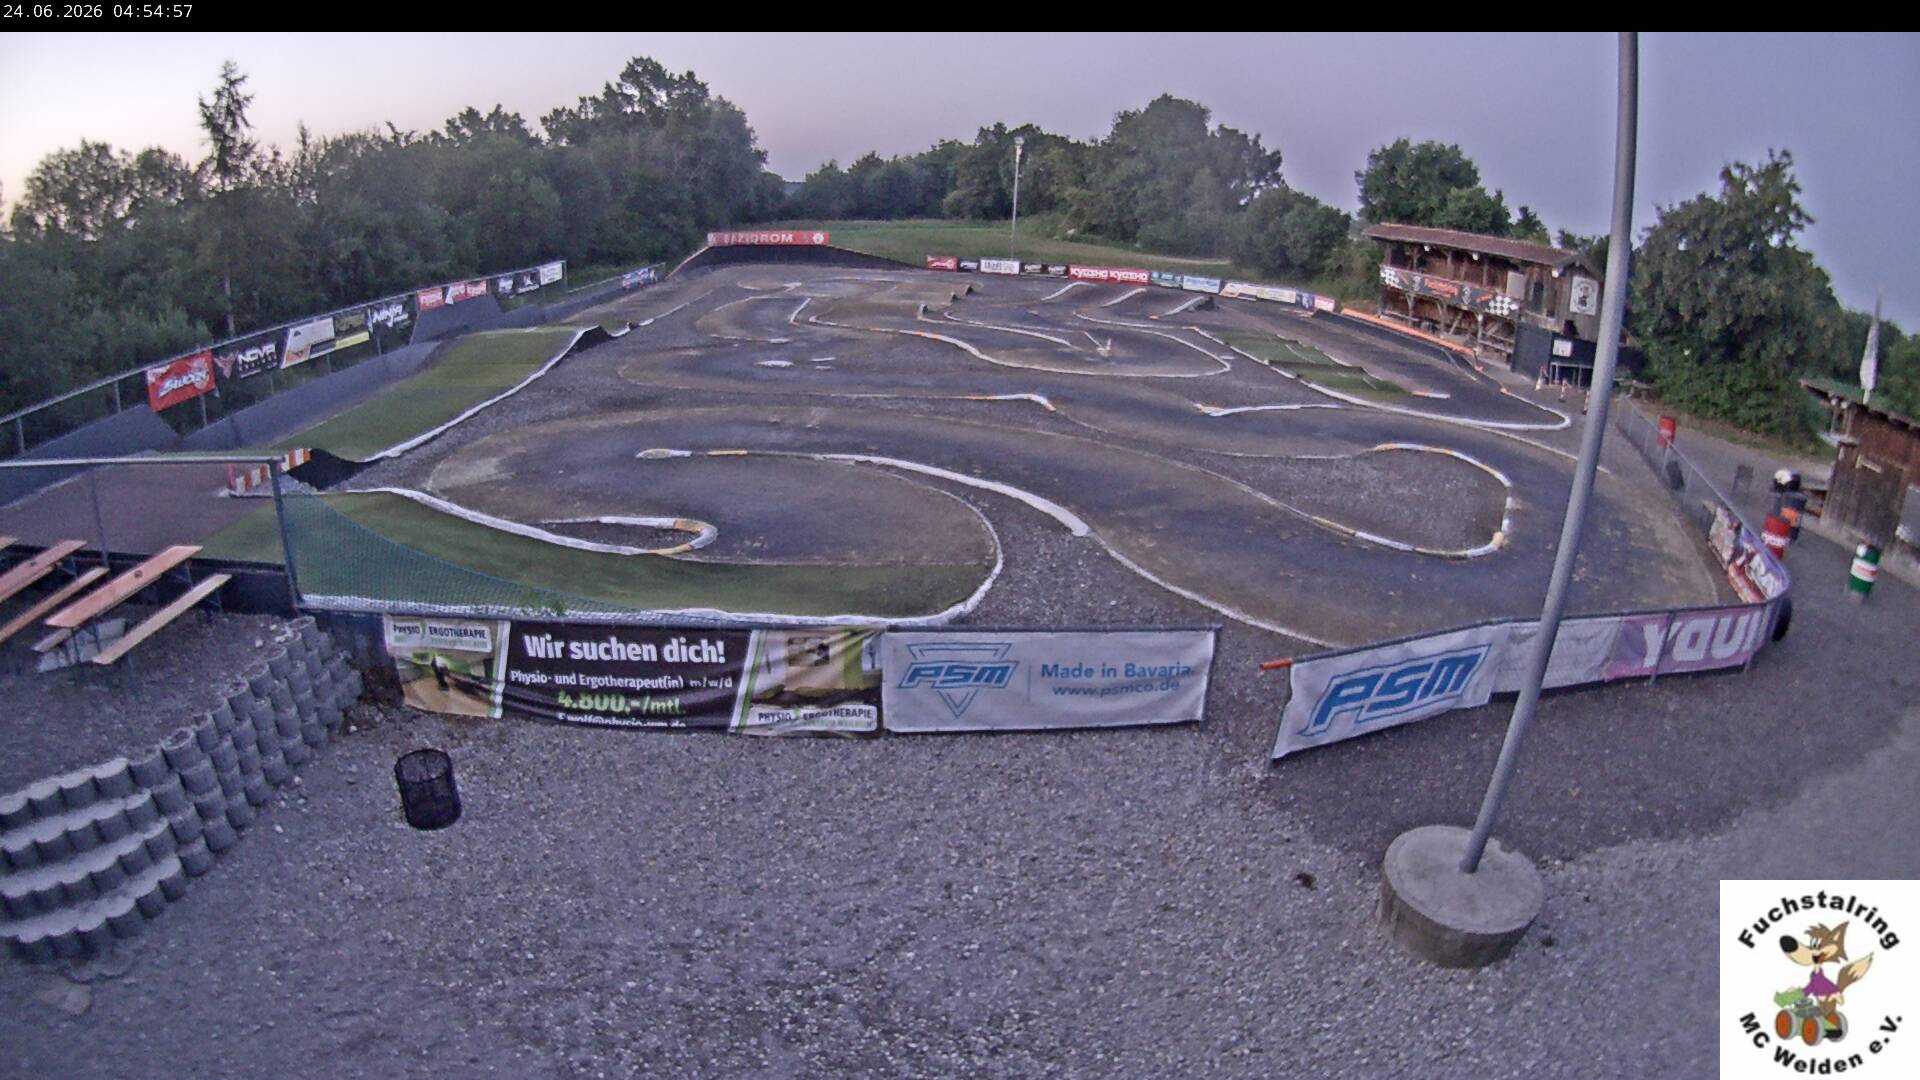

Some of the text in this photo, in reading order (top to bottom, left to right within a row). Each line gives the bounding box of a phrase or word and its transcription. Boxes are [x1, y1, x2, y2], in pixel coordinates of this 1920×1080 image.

[428, 625, 487, 640] ERGOTHERAPIE
[524, 633, 726, 664] Wir suchen dich!
[510, 670, 552, 685] Physio-
[554, 673, 577, 686] und
[579, 675, 684, 691] Ergotherapeut(in)
[902, 664, 1012, 686] PSM
[1041, 662, 1192, 679] Made in Bavaria
[1053, 680, 1181, 697] www.psmco.de
[1312, 653, 1482, 728] PSM
